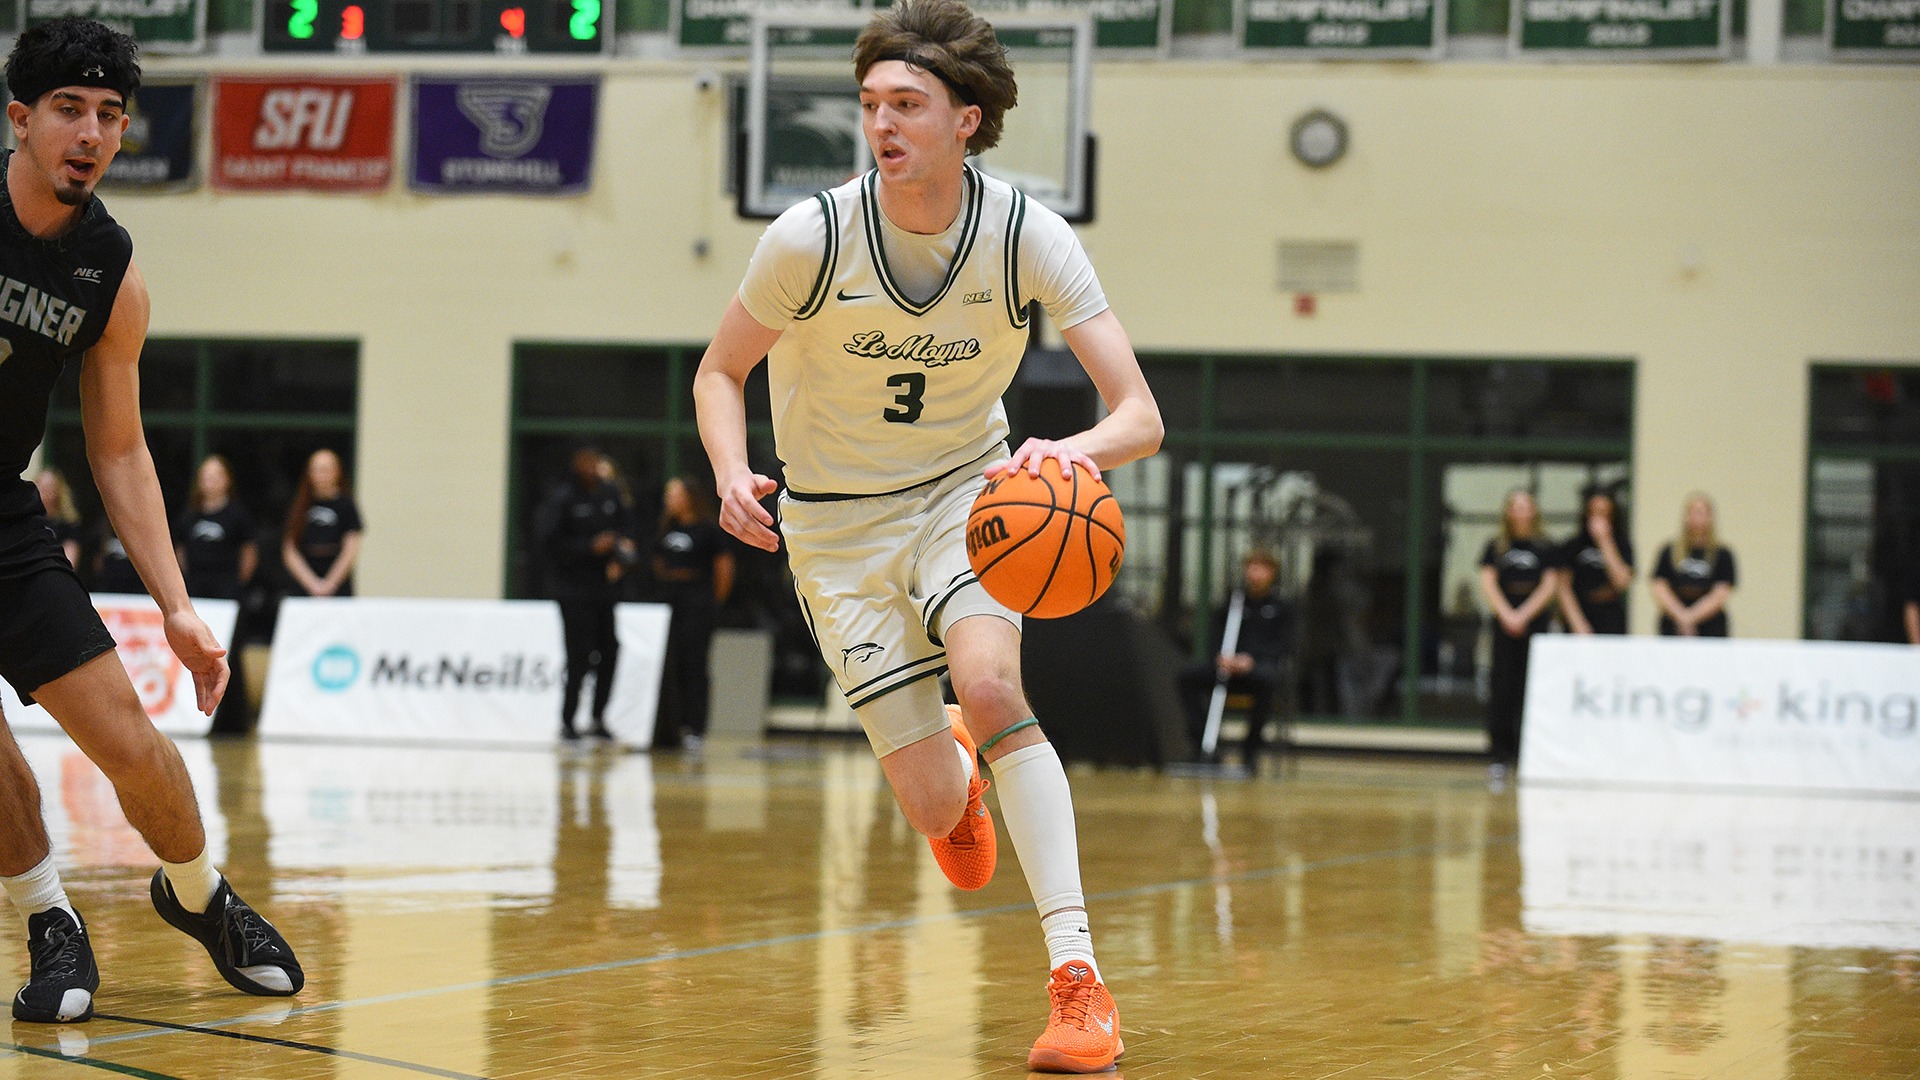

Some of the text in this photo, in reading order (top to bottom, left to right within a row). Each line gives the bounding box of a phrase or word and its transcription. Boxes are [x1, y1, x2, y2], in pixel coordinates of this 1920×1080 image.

[254, 88, 355, 149] SFU
[74, 267, 102, 280] NEC
[963, 289, 993, 305] NEC
[0, 275, 87, 346] GNER
[883, 372, 926, 424] 3
[966, 515, 1010, 557] Wil
[1572, 675, 1710, 733] king
[1777, 680, 1918, 739] king
